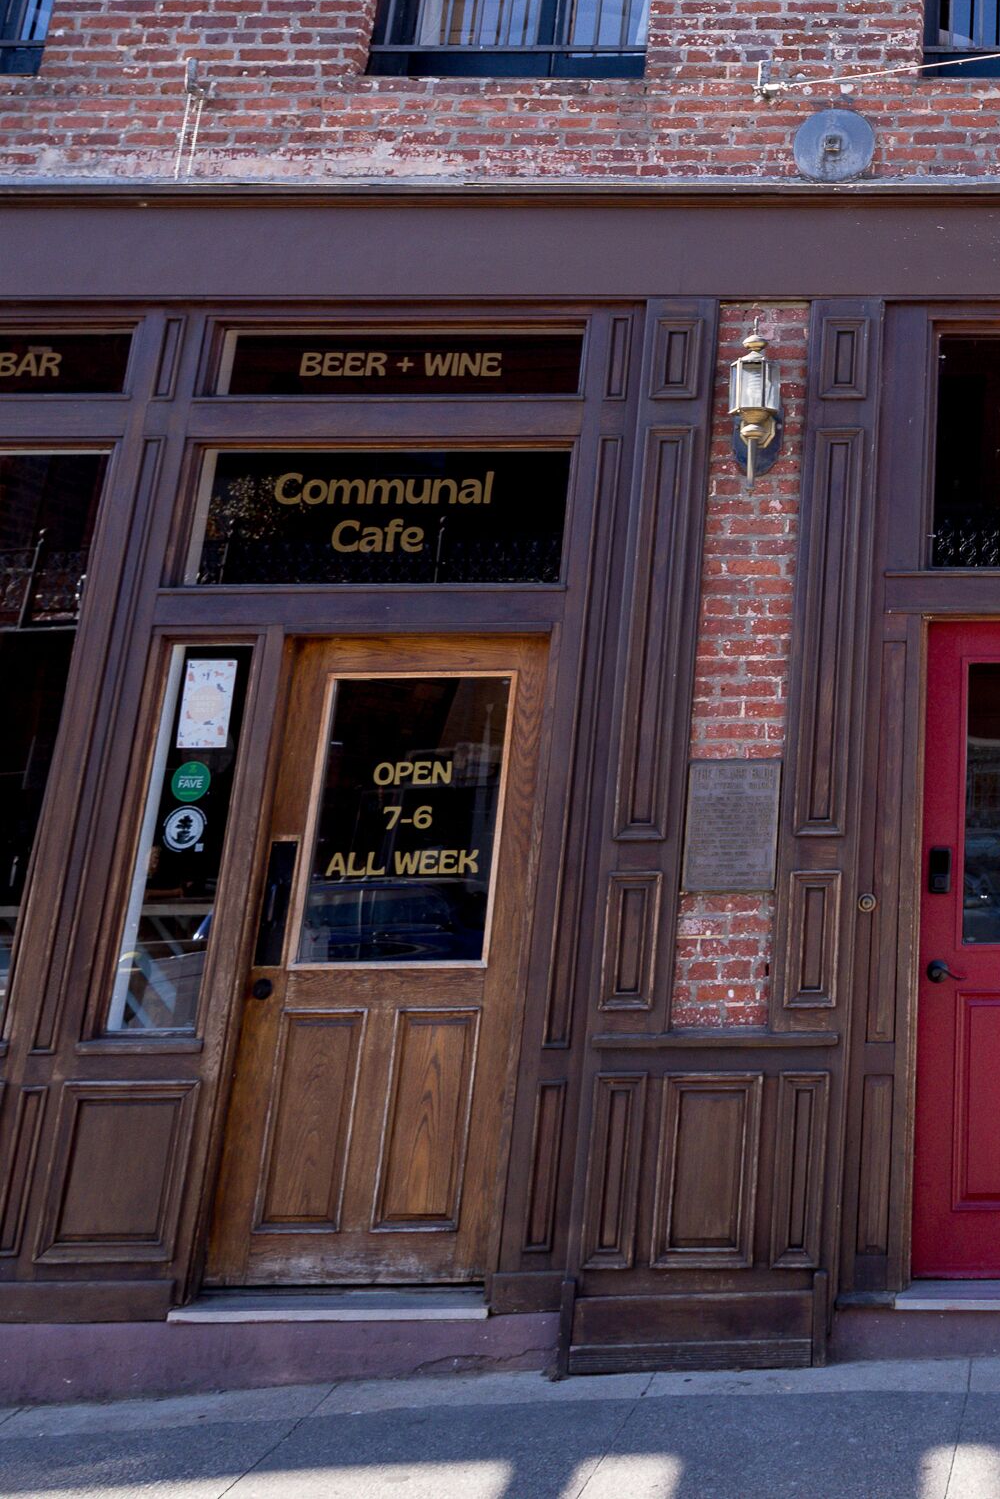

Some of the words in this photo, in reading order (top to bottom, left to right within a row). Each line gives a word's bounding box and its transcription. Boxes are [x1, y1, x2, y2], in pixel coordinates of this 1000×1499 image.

[0, 352, 62, 377] BAR
[299, 352, 387, 377] BEER
[396, 357, 415, 374] +
[425, 352, 503, 377] WINE
[274, 471, 495, 505] Communal
[331, 518, 425, 553] Cafe
[177, 779, 204, 789] FAVE
[373, 761, 453, 786] OPEN
[382, 806, 433, 830] 7-6
[325, 852, 385, 877] ALL
[394, 849, 480, 875] WEEK
